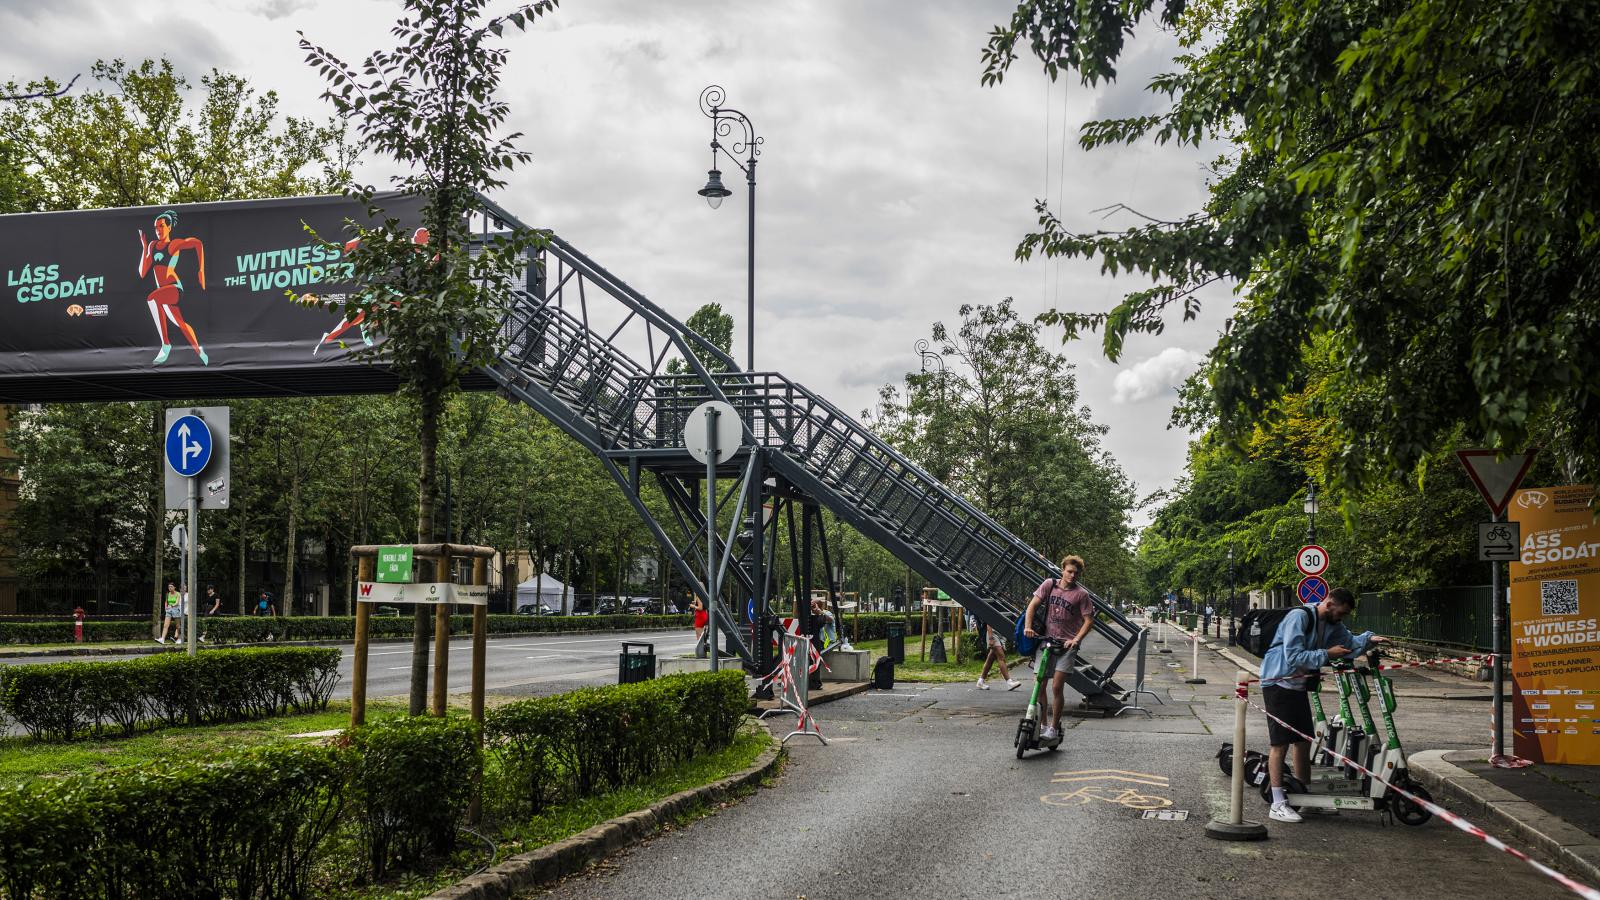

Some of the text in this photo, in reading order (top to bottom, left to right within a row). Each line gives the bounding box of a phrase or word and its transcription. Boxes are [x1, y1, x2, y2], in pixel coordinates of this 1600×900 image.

[236, 242, 341, 273] WITNESS
[7, 263, 60, 287] LÁSS
[224, 275, 247, 287] THE
[16, 275, 104, 303] CSODÁT!
[1520, 533, 1561, 551] ÁSS
[1304, 554, 1320, 567] 30
[1521, 541, 1600, 565] CSODÁT
[360, 583, 373, 596] W
[1523, 619, 1597, 636] WITNESS
[1515, 637, 1531, 645] THE
[1533, 657, 1593, 669] ROUTE PLANNER:
[1516, 669, 1551, 678] BUDAPEST
